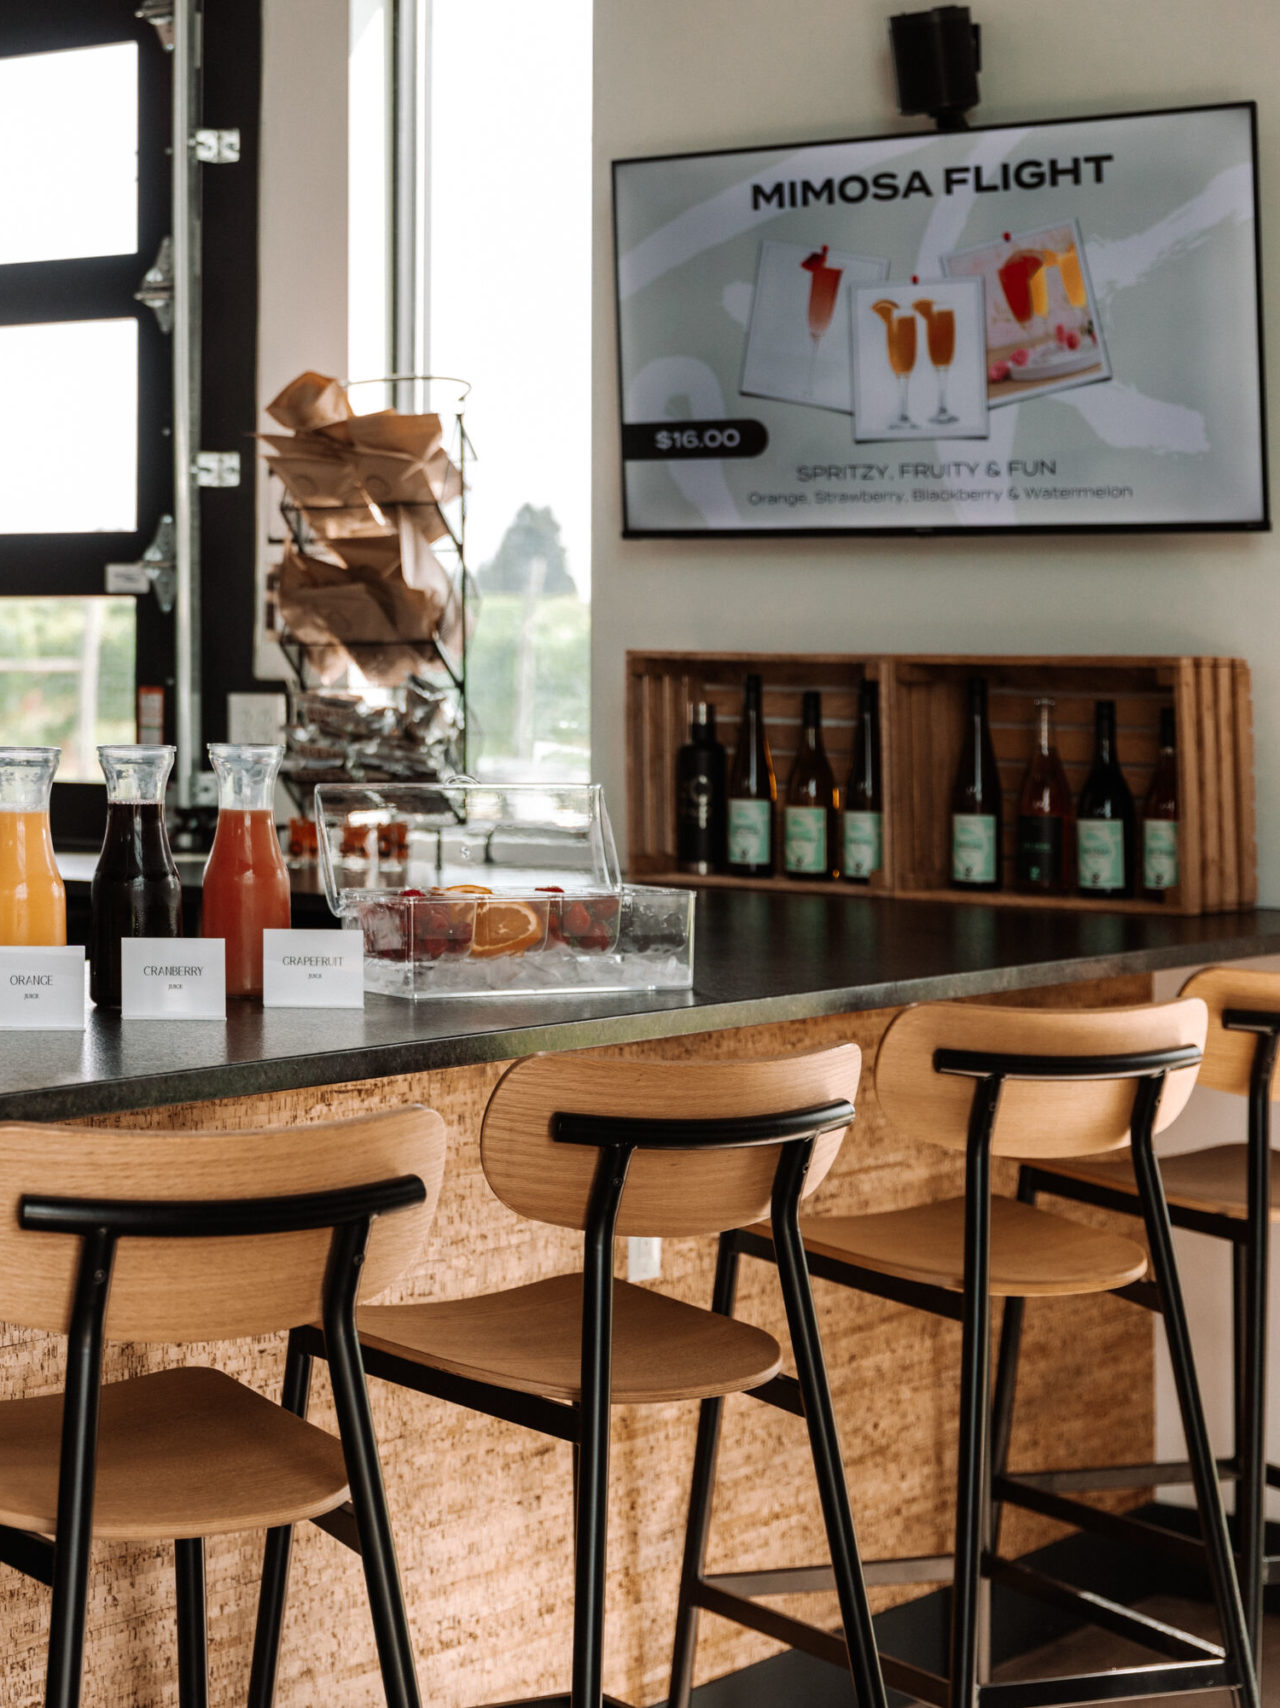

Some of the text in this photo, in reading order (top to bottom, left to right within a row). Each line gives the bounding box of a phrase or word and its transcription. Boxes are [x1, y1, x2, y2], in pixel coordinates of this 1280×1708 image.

[751, 154, 1114, 211] MIMOSA FLIGHT
[654, 428, 741, 451] $16.00
[795, 458, 1058, 483] SPRITZY, FRUITY & FUN
[912, 486, 1003, 503] Blackberry
[1008, 487, 1020, 501] &
[1024, 484, 1134, 500] Watermelon
[143, 965, 204, 977] CRANBERRY
[282, 955, 344, 968] GRAPEFRUIT
[9, 974, 54, 986] ORANGE
